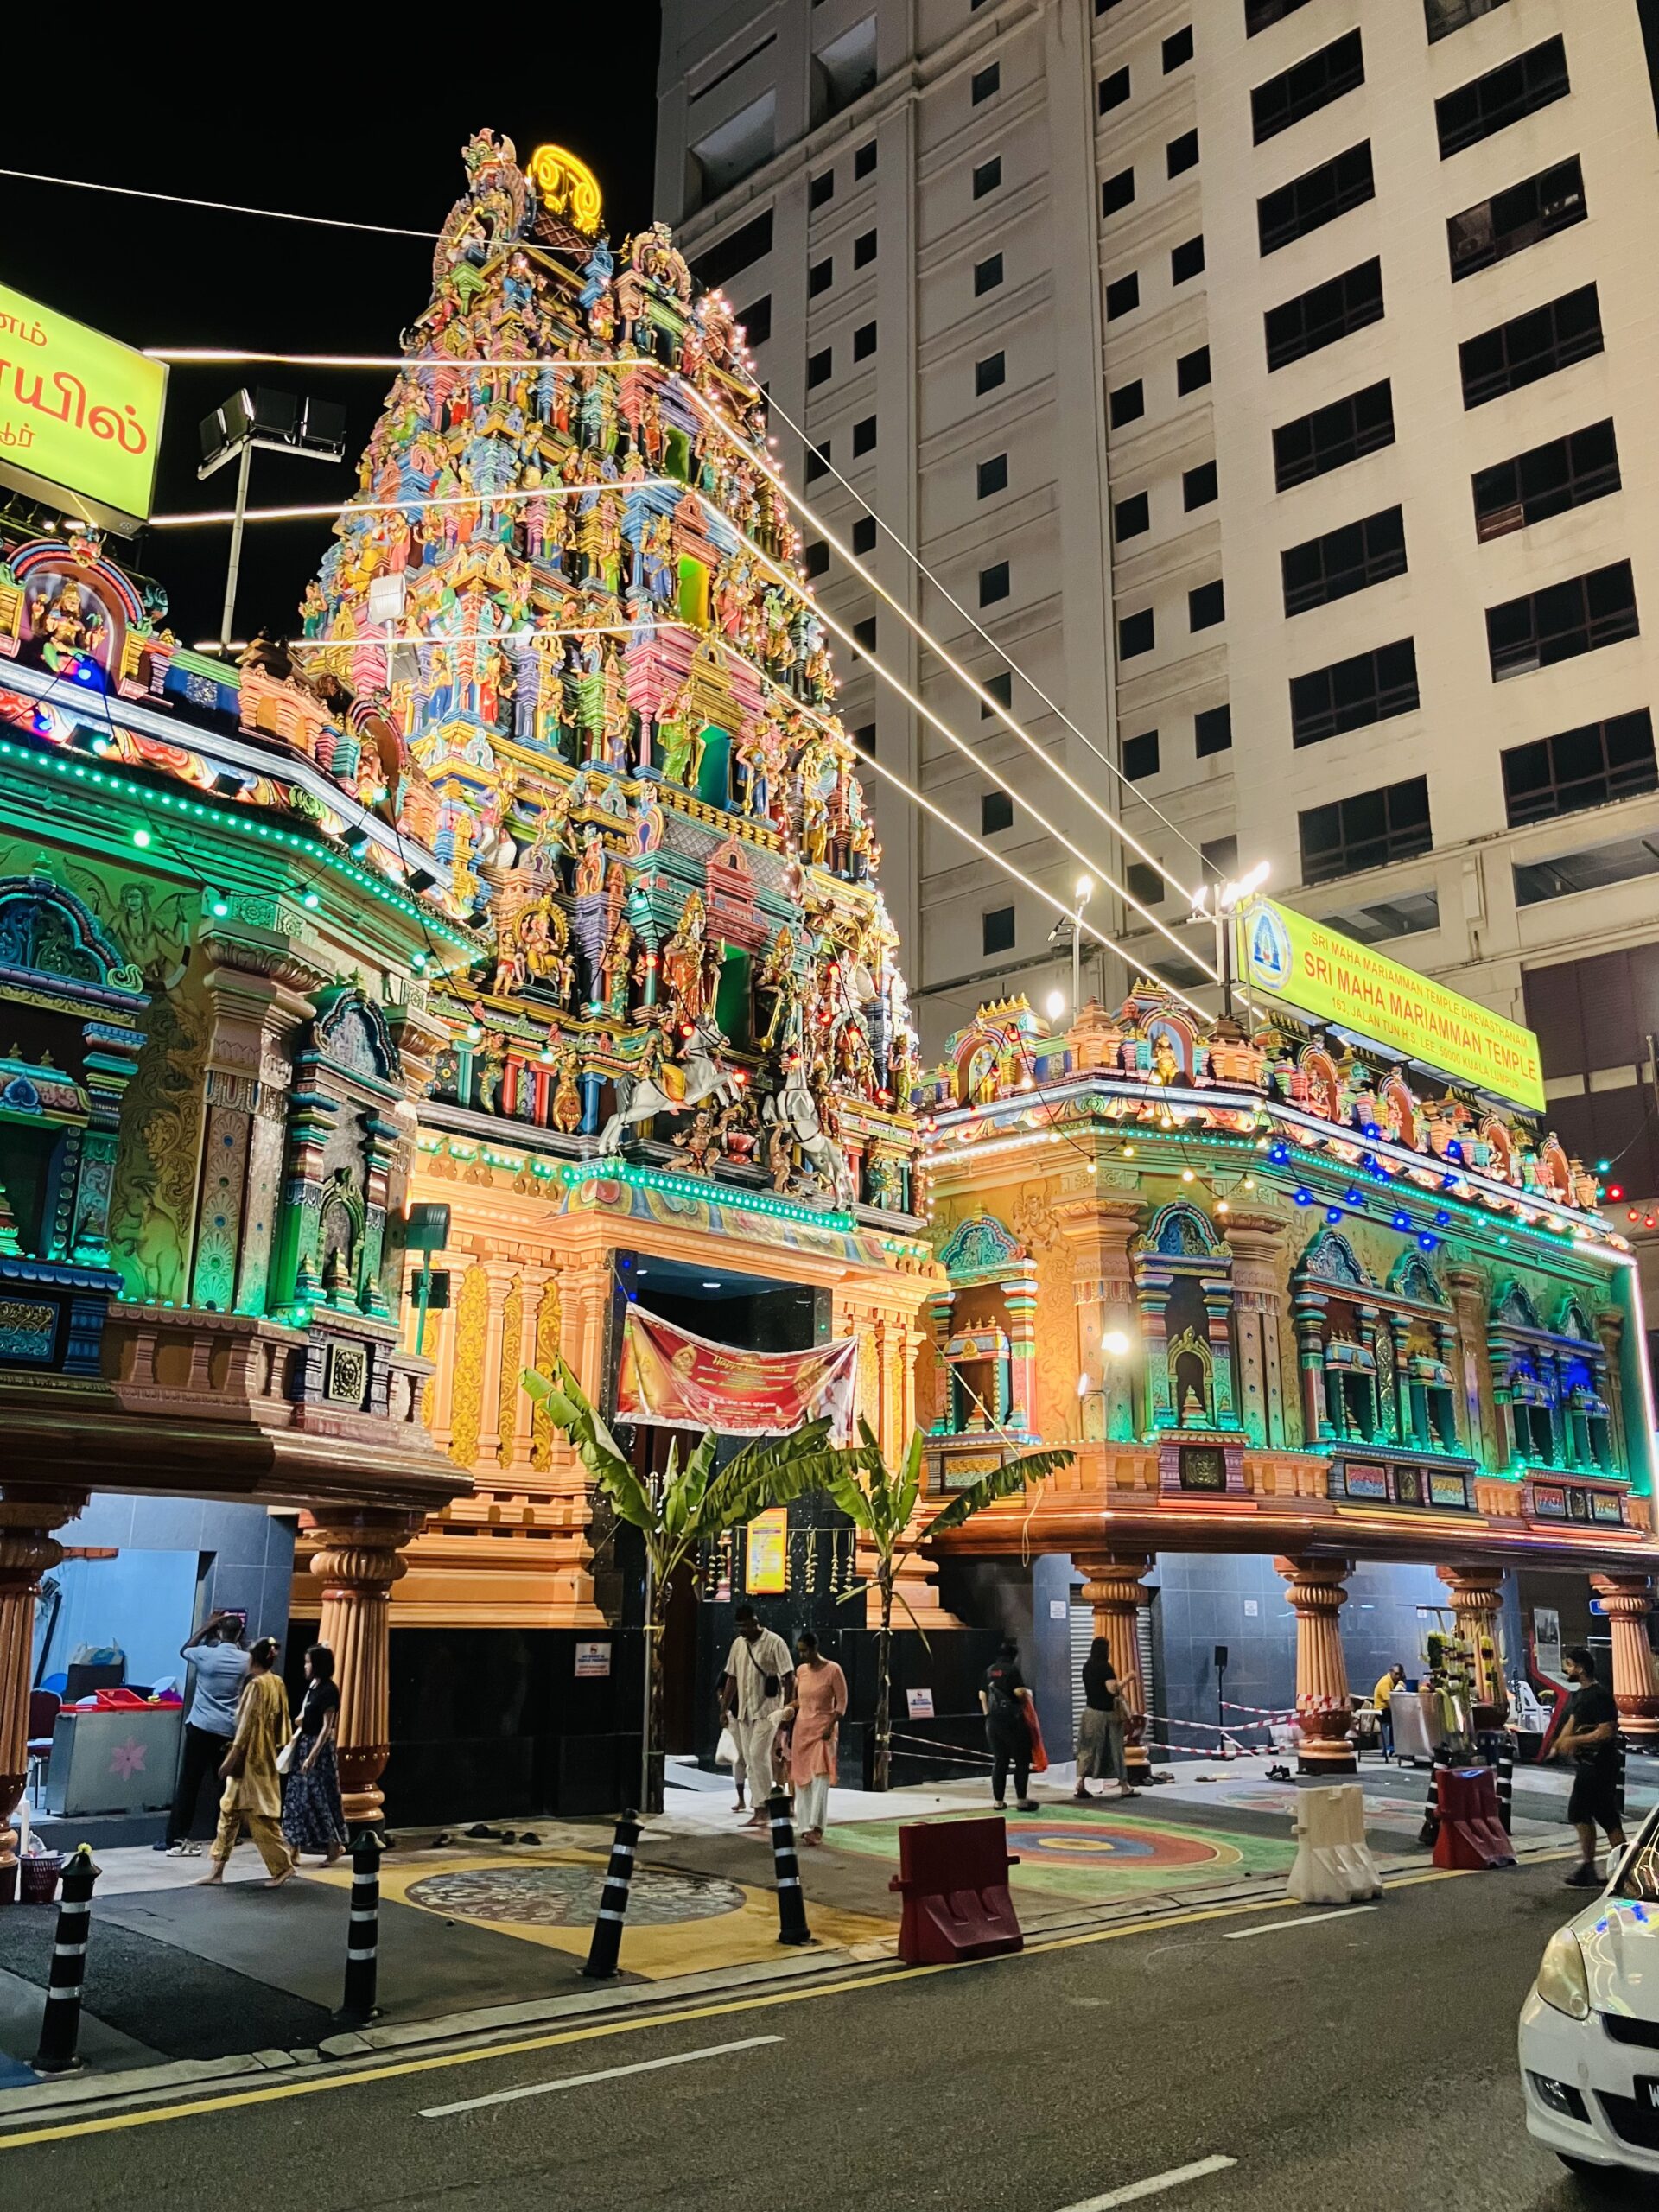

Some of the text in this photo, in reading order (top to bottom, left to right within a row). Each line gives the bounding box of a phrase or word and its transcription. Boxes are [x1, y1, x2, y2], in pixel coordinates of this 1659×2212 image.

[1304, 951, 1537, 1081] SRI MAHA MARIAMMAN TEMPLE
[1312, 931, 1528, 1048] SRI MAHA MARIAMMAN TEMPLE DHEVASTHANAM
[1351, 1006, 1381, 1028] JALAN
[1382, 1019, 1400, 1038] TUN
[1462, 1057, 1489, 1077] KUALA
[1490, 1068, 1520, 1090] LUMPUR
